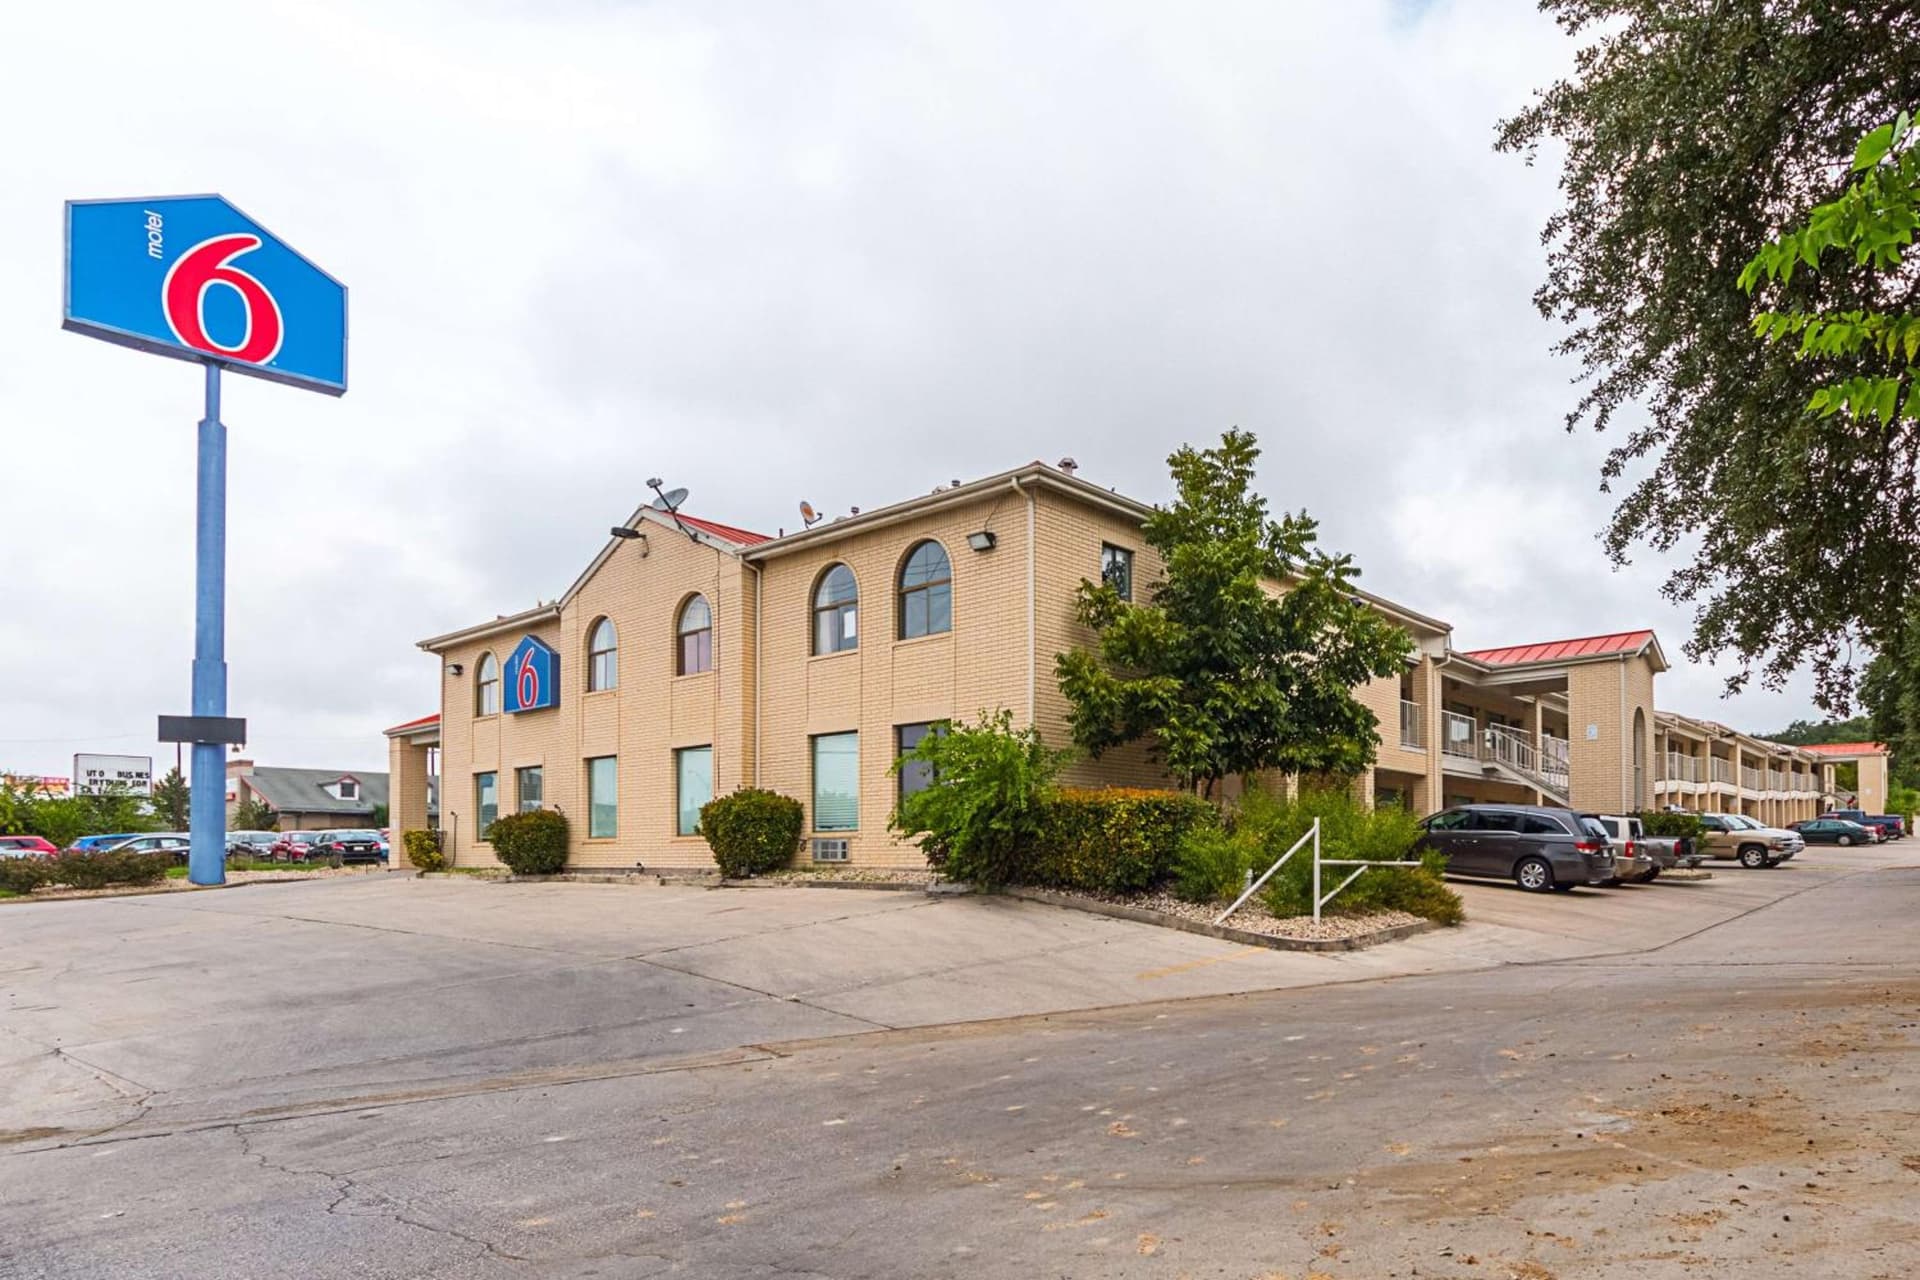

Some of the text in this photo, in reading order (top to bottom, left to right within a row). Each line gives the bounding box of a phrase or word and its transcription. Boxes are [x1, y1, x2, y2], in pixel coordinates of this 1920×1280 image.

[143, 209, 163, 259] motel
[161, 232, 284, 365] 6
[517, 647, 539, 709] 6
